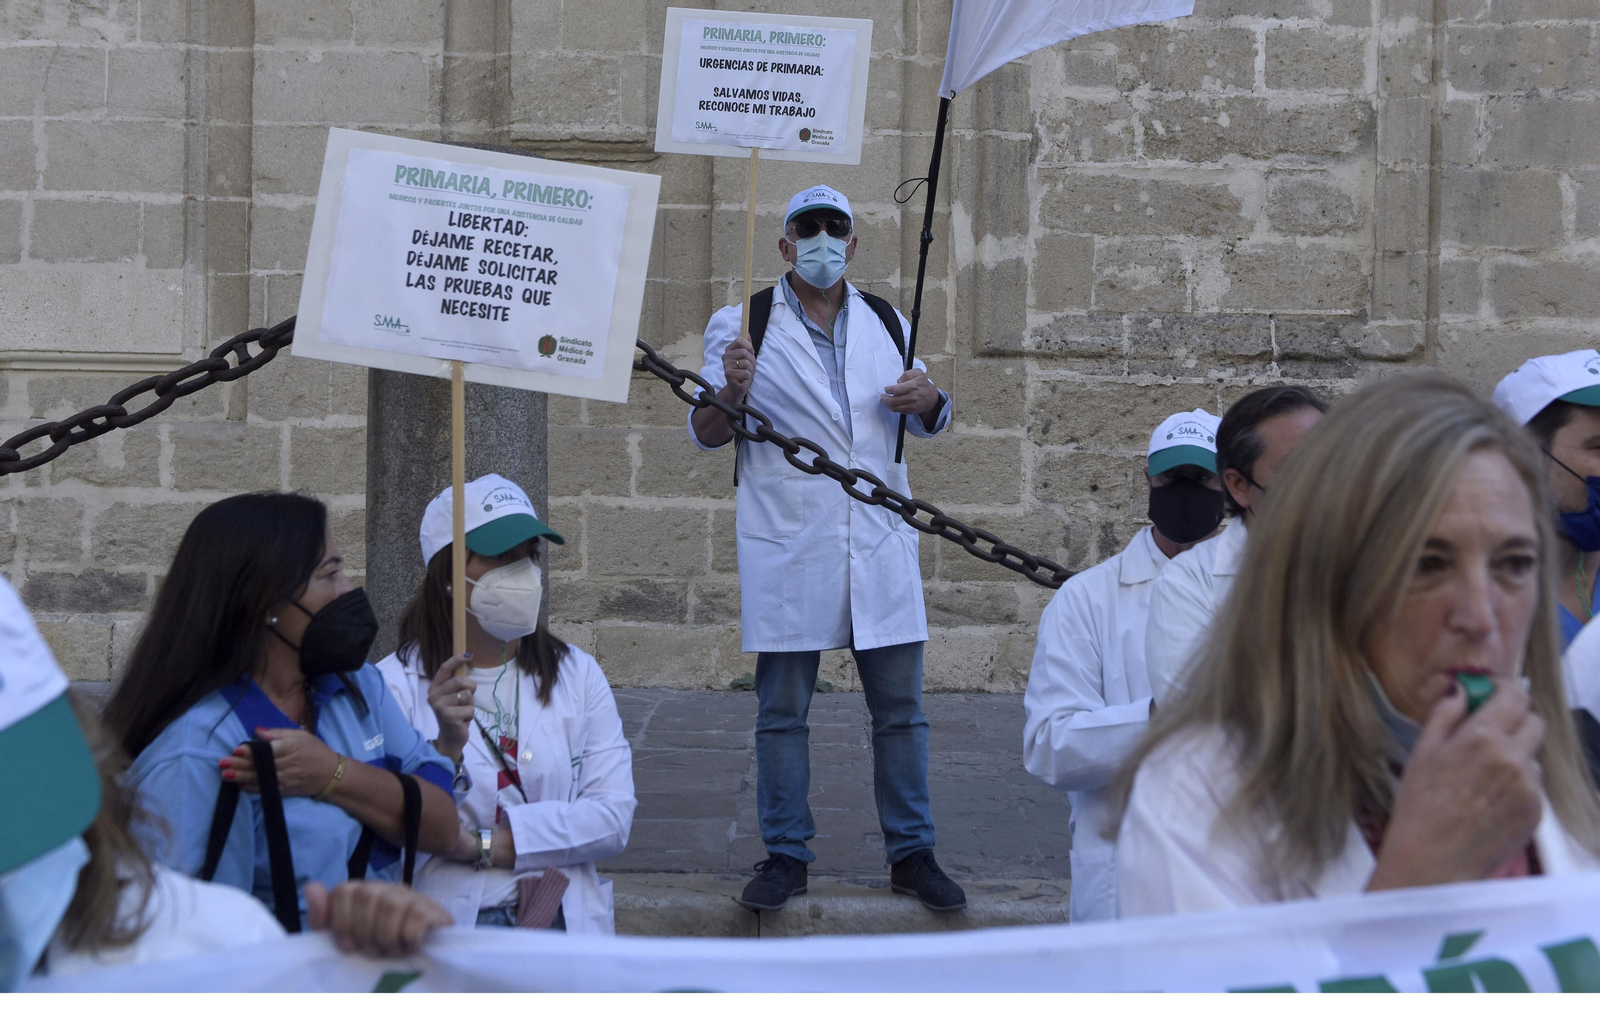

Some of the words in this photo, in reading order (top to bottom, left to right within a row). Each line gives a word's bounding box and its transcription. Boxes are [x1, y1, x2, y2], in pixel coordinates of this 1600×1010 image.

[703, 26, 766, 44] PRIMARIA,
[769, 31, 826, 47] PRIMERO:
[699, 57, 754, 71] URGENCIAS
[756, 61, 768, 72] DE
[770, 62, 824, 76] PRIMARIA:
[713, 86, 769, 101] SALVAMOS
[772, 91, 804, 104] VIDAS,
[698, 100, 750, 113] RECONOCE
[752, 104, 766, 115] MI
[768, 105, 816, 118] TRABAJO
[695, 121, 716, 130] SMA
[394, 164, 497, 199] PRIMARIA,
[502, 179, 594, 210] PRIMERO:
[423, 198, 457, 208] PACIENTES
[457, 202, 482, 212] JUNTOS
[497, 207, 510, 216] UNA
[511, 210, 547, 222] ASISTENCIA
[548, 215, 556, 223] DE
[557, 217, 583, 226] CALIDAD
[448, 210, 529, 238] LIBERTAD:
[411, 229, 475, 251] DÉJAME
[483, 238, 558, 265] RECETAR,
[406, 250, 470, 272] DÉJAME
[477, 259, 558, 286] SOLICITAR
[405, 272, 436, 291] LAS
[443, 276, 514, 301] PRUEBAS
[522, 288, 552, 306] QUE
[440, 298, 511, 322] NECESITE
[374, 314, 408, 329] SMA
[558, 345, 584, 355] Médico
[559, 336, 593, 348] Sindicato
[557, 354, 587, 365] Granada
